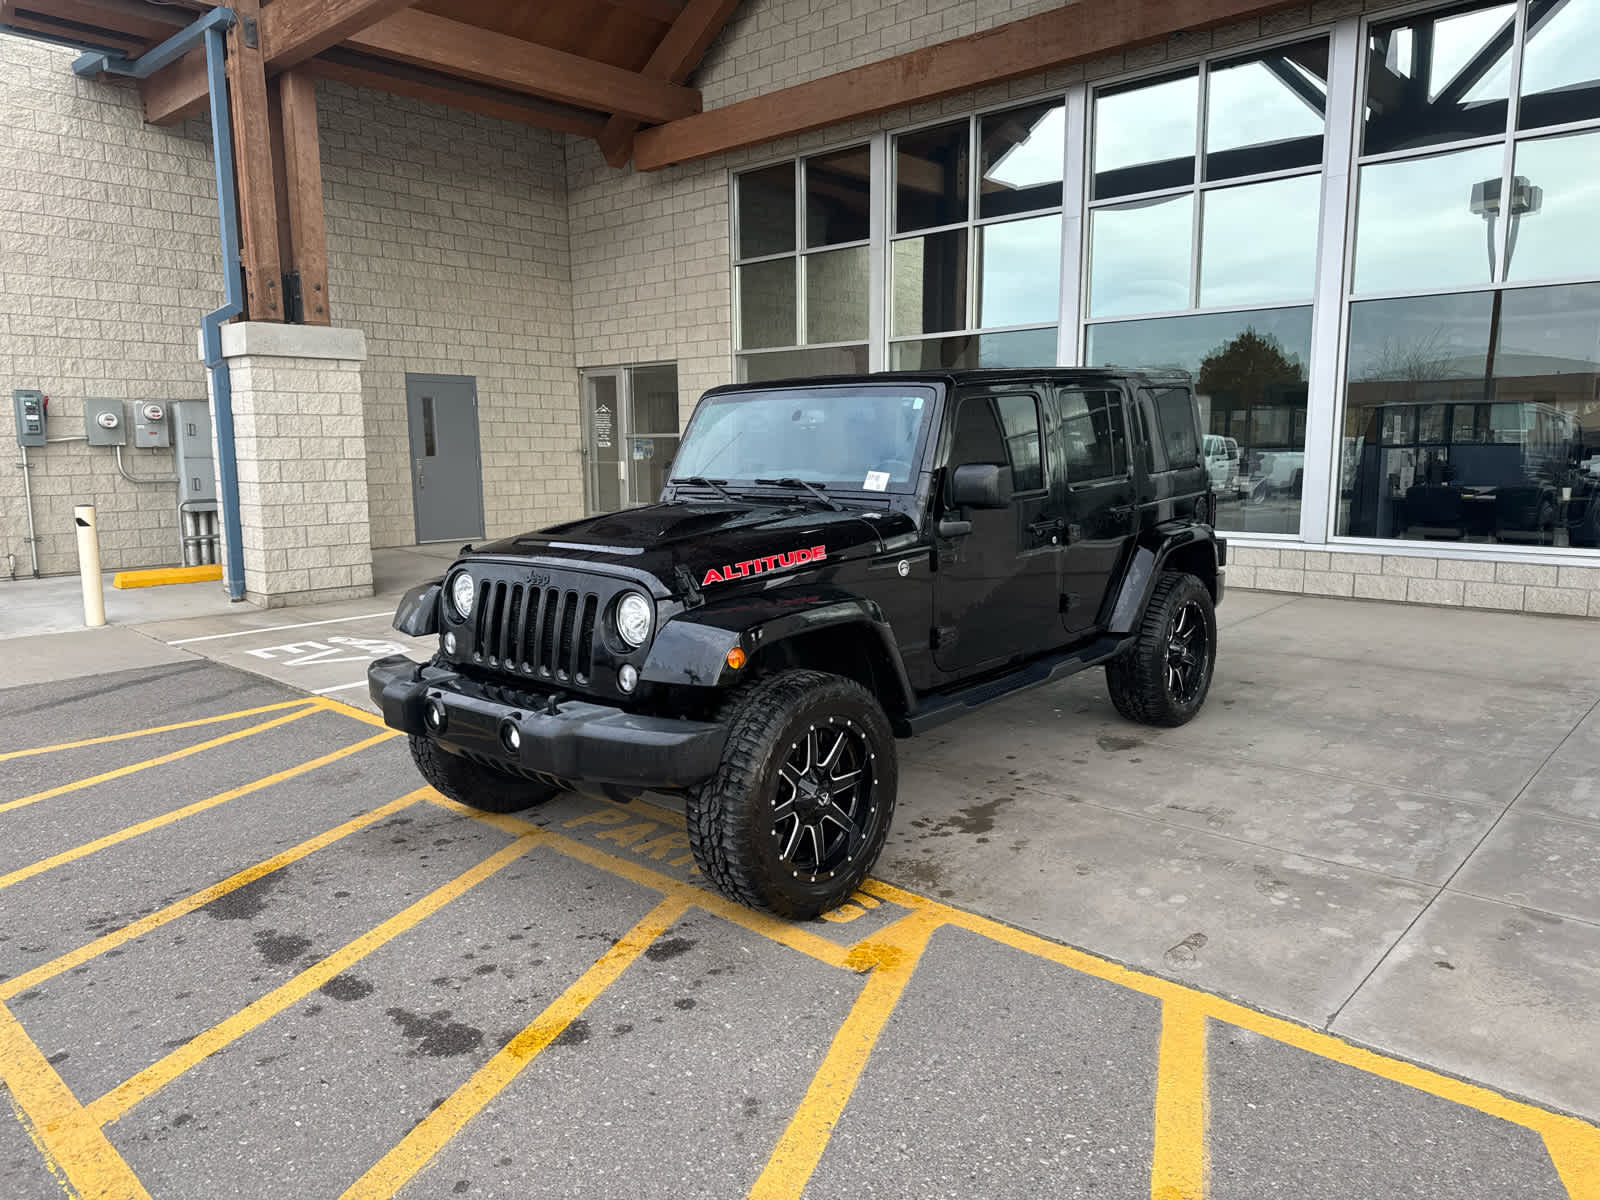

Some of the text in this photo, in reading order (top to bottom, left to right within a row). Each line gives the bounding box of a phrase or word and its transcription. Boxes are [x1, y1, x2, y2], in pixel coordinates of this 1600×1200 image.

[526, 569, 551, 587] Jeep
[702, 545, 827, 586] ALTITUDE
[245, 641, 373, 666] EV
